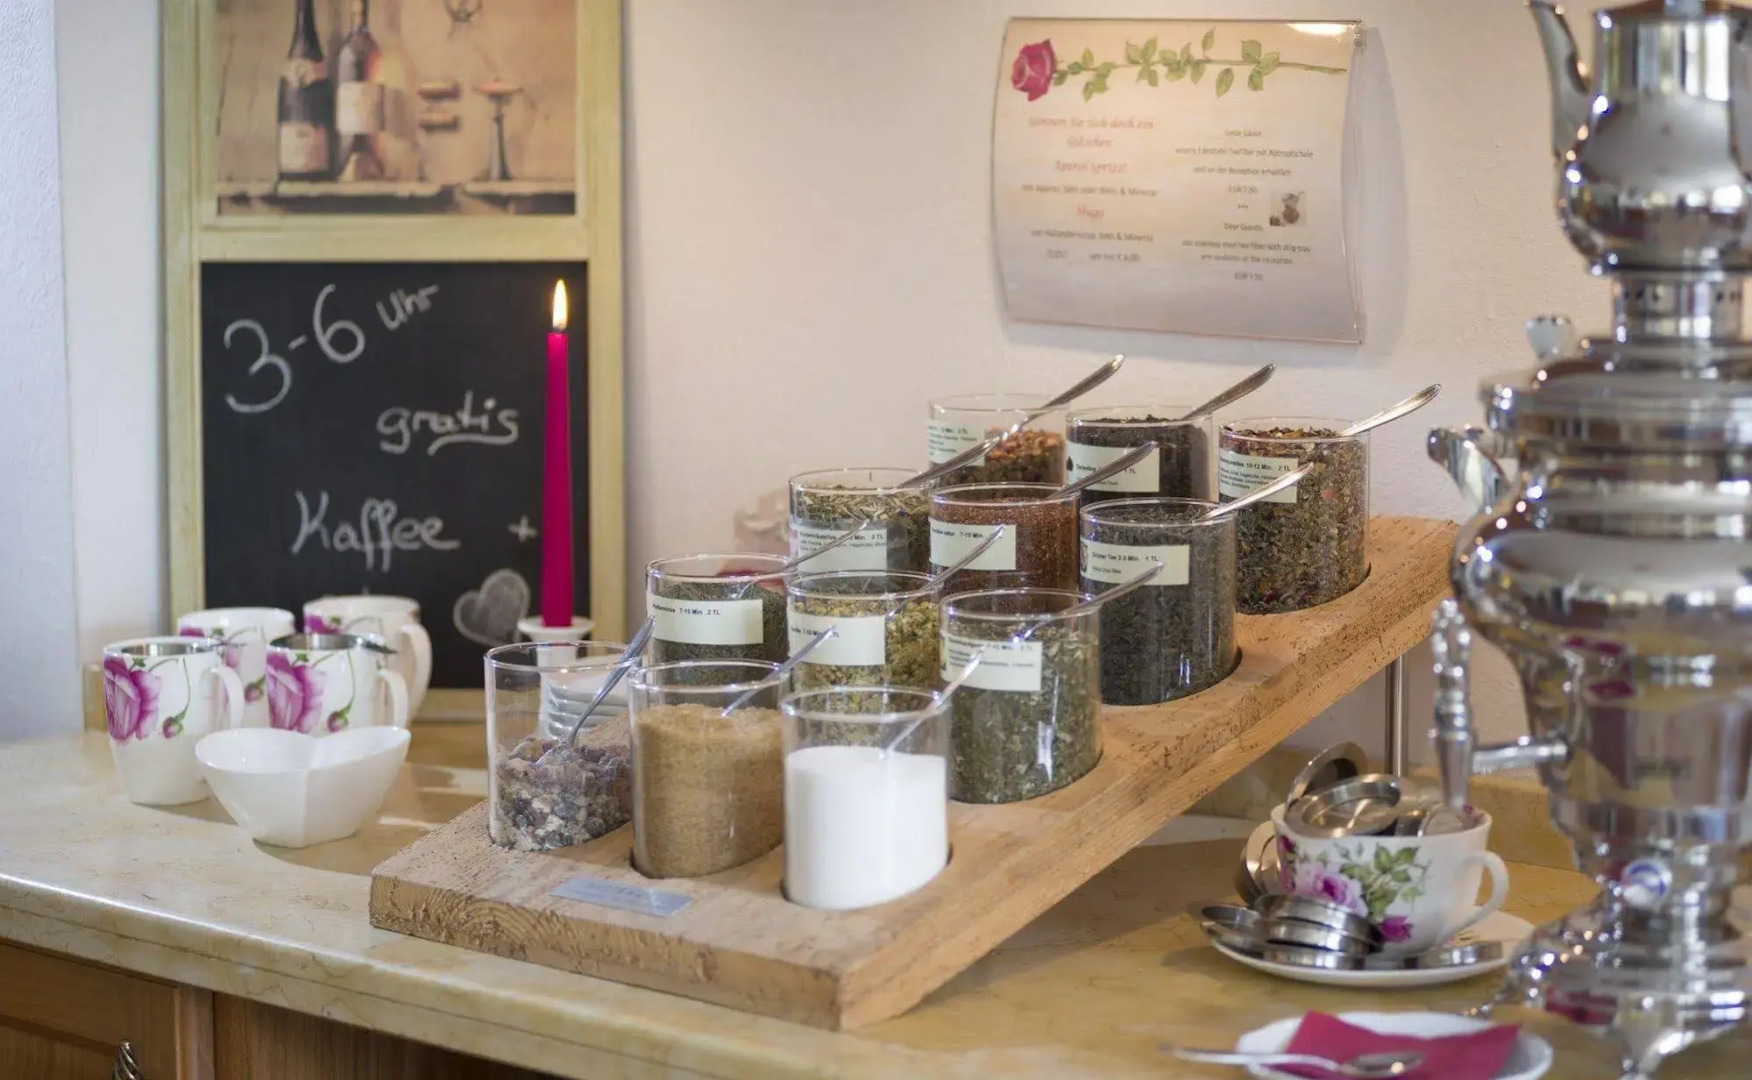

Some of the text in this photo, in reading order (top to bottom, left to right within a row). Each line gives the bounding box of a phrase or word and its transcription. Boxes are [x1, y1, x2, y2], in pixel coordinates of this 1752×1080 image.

[375, 283, 441, 334] Uhr
[376, 390, 520, 456] gratis
[290, 489, 462, 574] Kaffee
